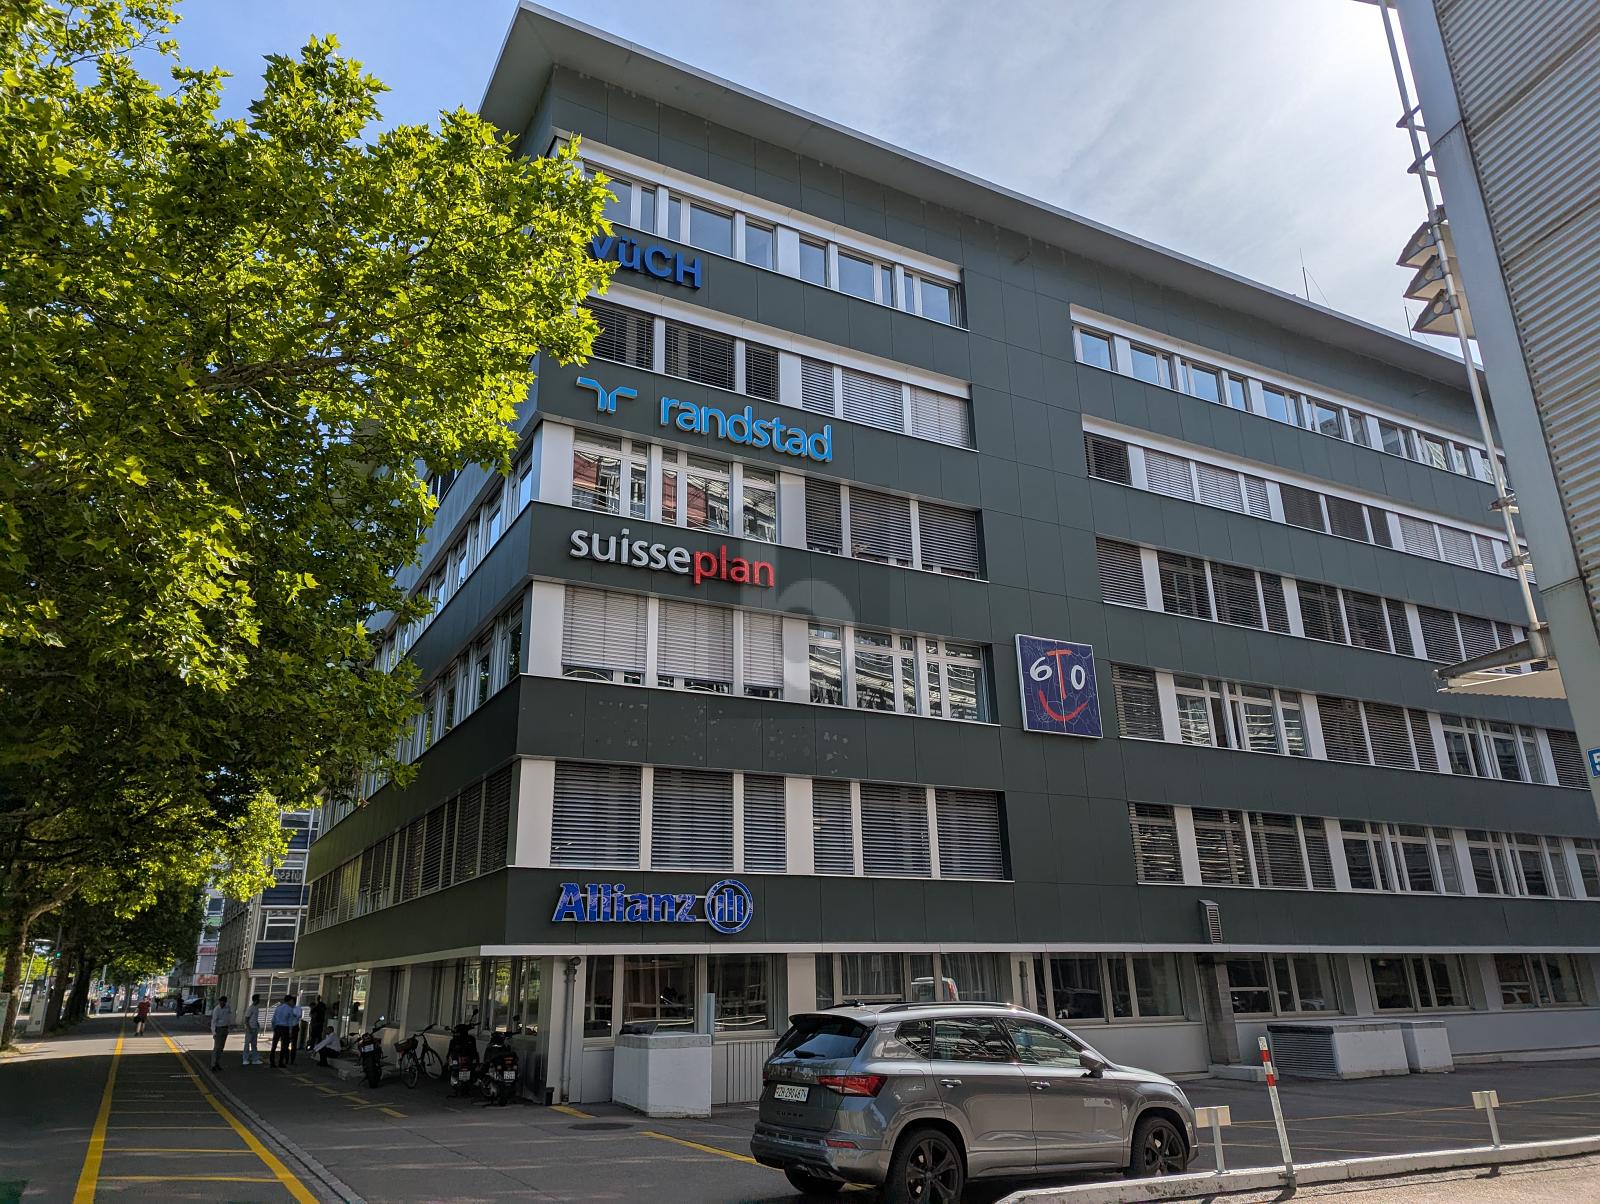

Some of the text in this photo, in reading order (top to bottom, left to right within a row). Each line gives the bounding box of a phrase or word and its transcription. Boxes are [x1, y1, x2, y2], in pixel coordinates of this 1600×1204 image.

[660, 396, 832, 463] randstad
[569, 528, 775, 587] suisseplan
[552, 883, 697, 922] Allianz
